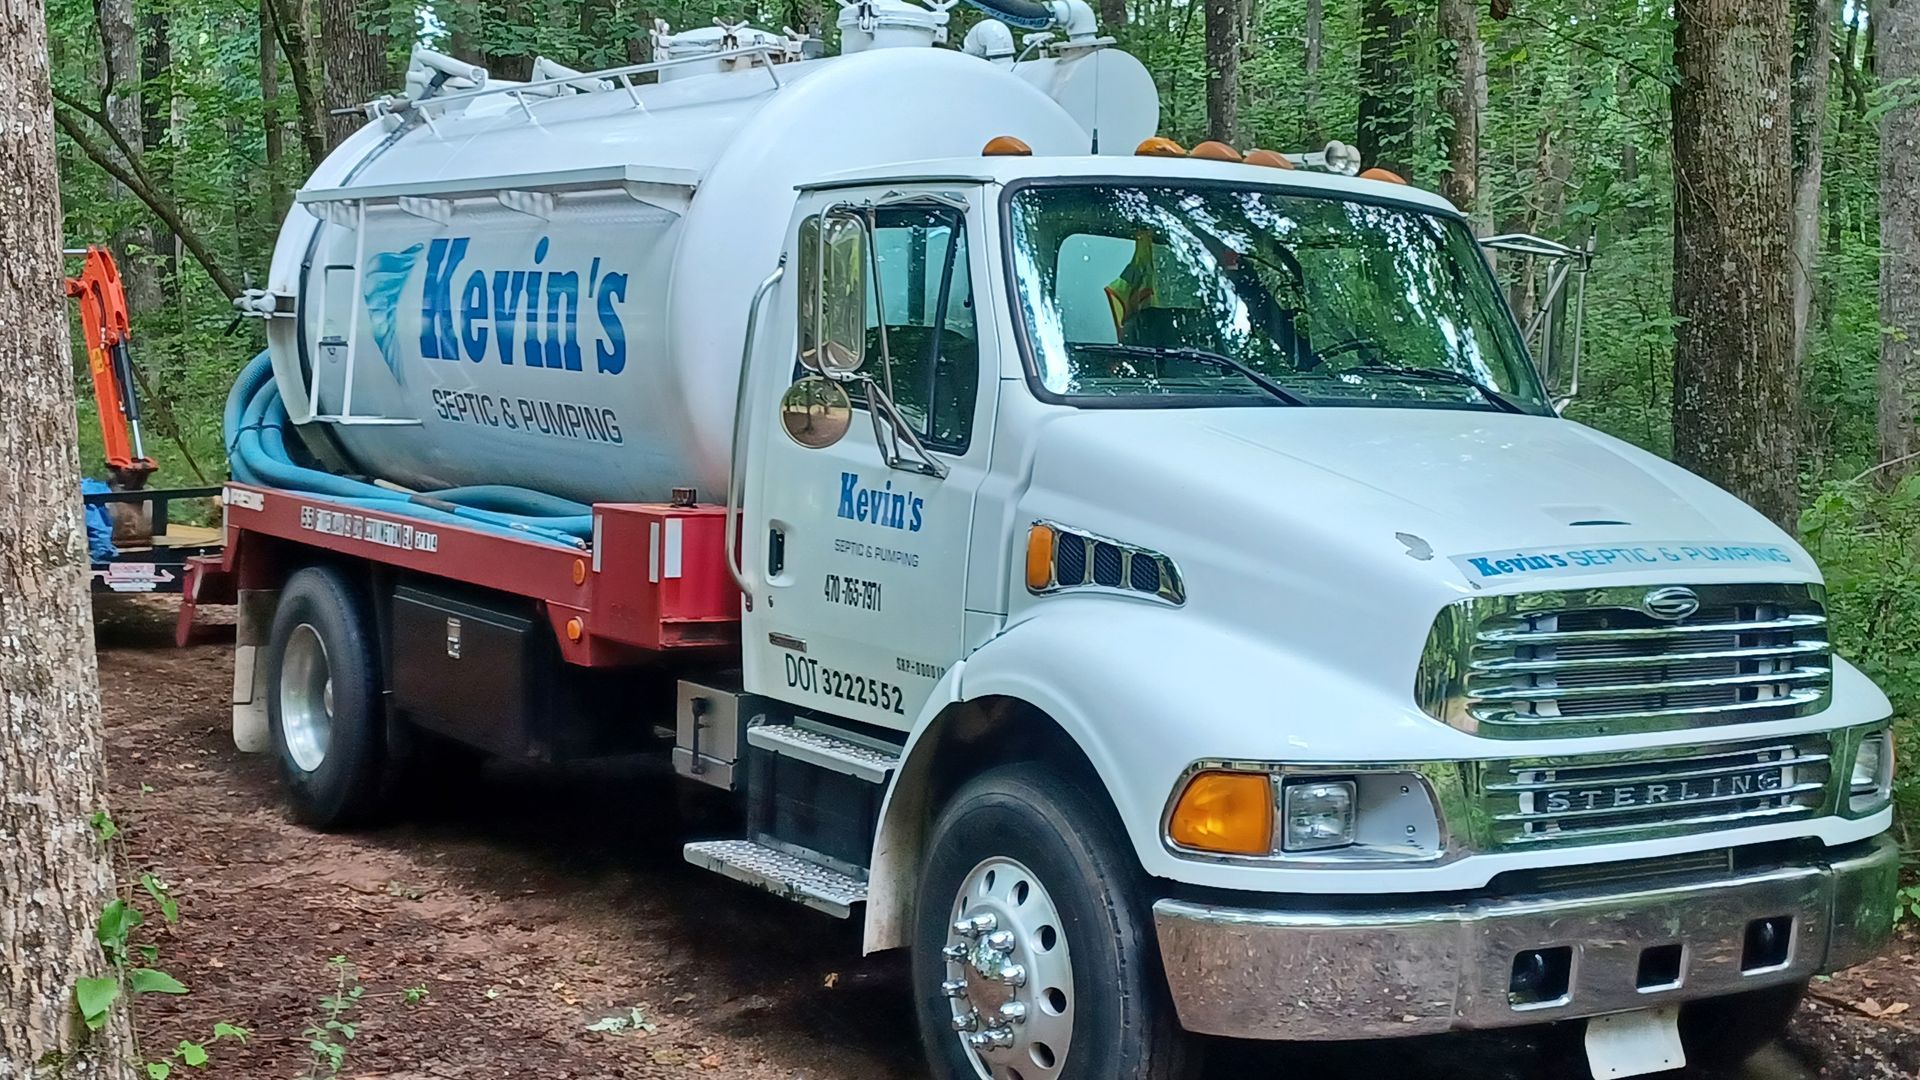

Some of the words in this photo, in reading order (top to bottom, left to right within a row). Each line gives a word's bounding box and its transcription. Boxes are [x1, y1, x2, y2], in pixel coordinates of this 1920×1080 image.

[419, 236, 629, 376] Kevin's
[432, 388, 499, 428] SEPTIC
[499, 397, 520, 430] &
[518, 399, 624, 445] PUMPING
[837, 472, 924, 532] Kevin's
[834, 538, 864, 556] SEPTIC
[865, 546, 873, 558] &
[874, 546, 920, 568] PUMPING
[1468, 553, 1570, 578] Kevin's
[1566, 547, 1657, 567] SEPTIC
[1661, 547, 1682, 562] &
[1688, 546, 1793, 564] PUMPING
[824, 574, 882, 612] 470-765-7971
[785, 653, 818, 694] DOT
[822, 668, 905, 716] 3222552
[1547, 769, 1782, 814] STERLING
